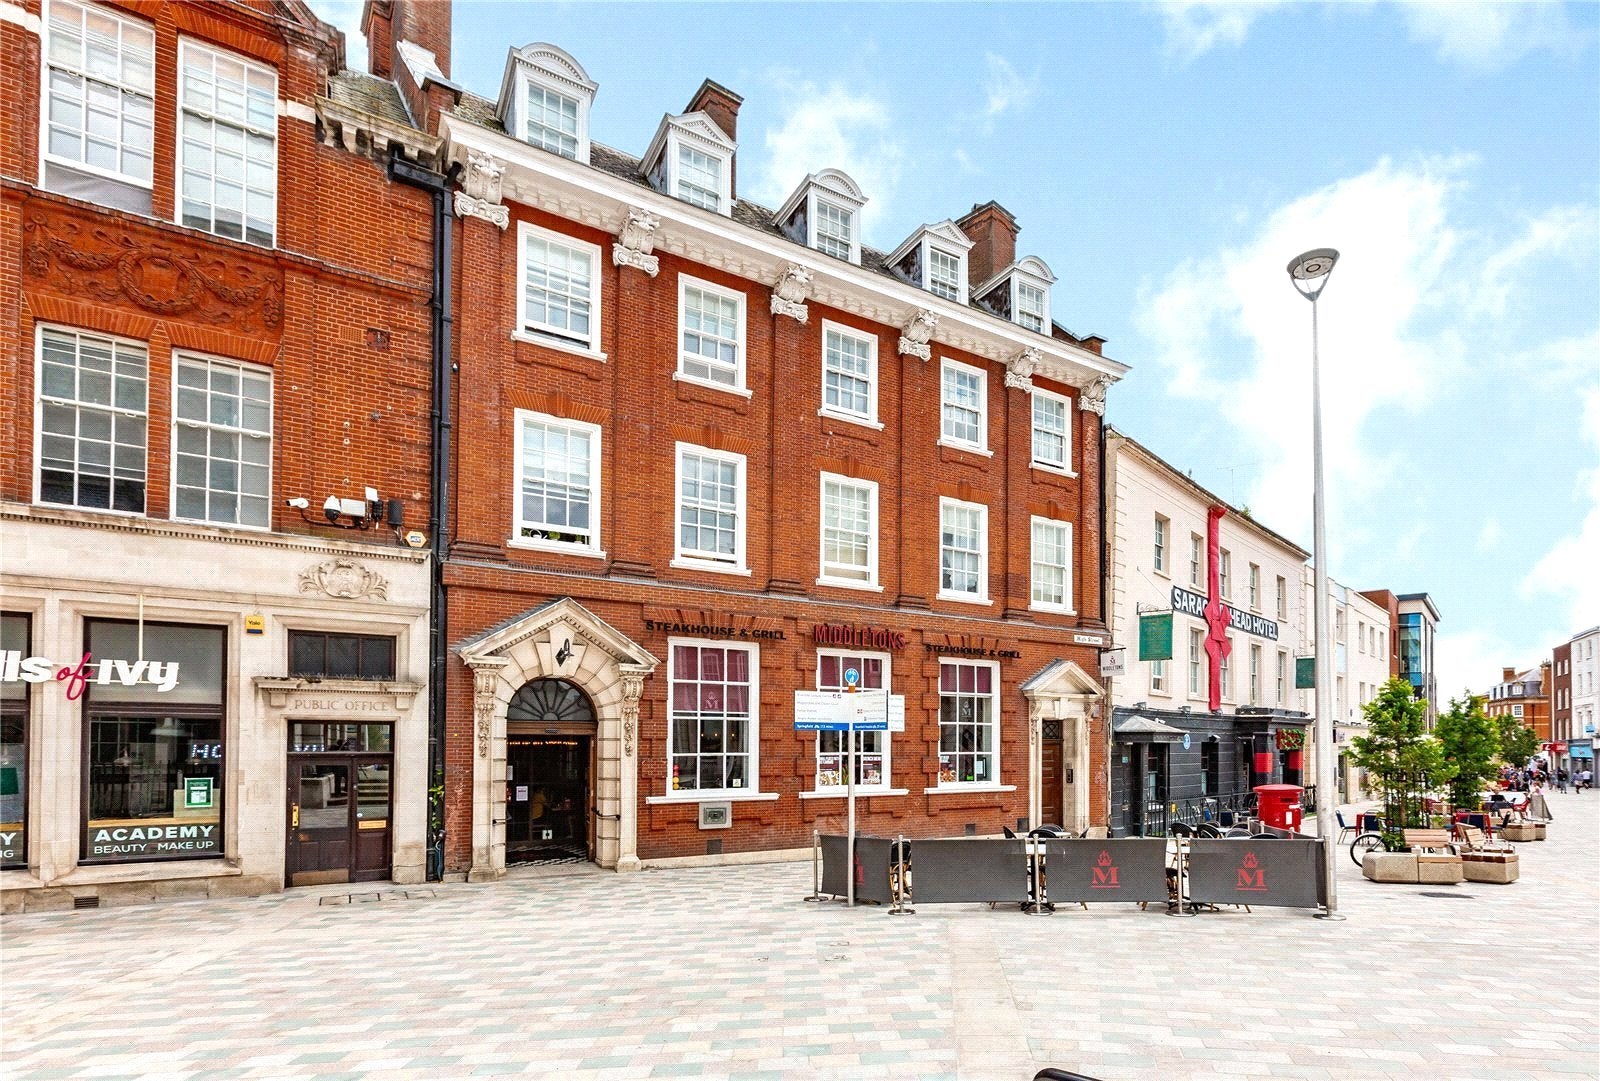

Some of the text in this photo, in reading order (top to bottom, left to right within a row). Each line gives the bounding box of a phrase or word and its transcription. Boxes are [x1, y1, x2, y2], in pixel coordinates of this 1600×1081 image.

[646, 620, 787, 641] STEAKHOUSE & GRILL
[1229, 608, 1252, 630] HEAD
[1253, 616, 1277, 638] HOTEL
[813, 623, 906, 650] MIDDLETONS
[926, 644, 1021, 659] STEAKHOUSE & GRILL
[56, 652, 95, 700] of
[294, 699, 389, 711] PUBLIC OFFICE
[704, 699, 719, 709] M
[961, 708, 972, 716] M
[94, 825, 215, 842] ACADEMY
[94, 840, 215, 854] BEAUTY MAKE UP
[1091, 867, 1120, 885] M
[1236, 868, 1266, 887] M
